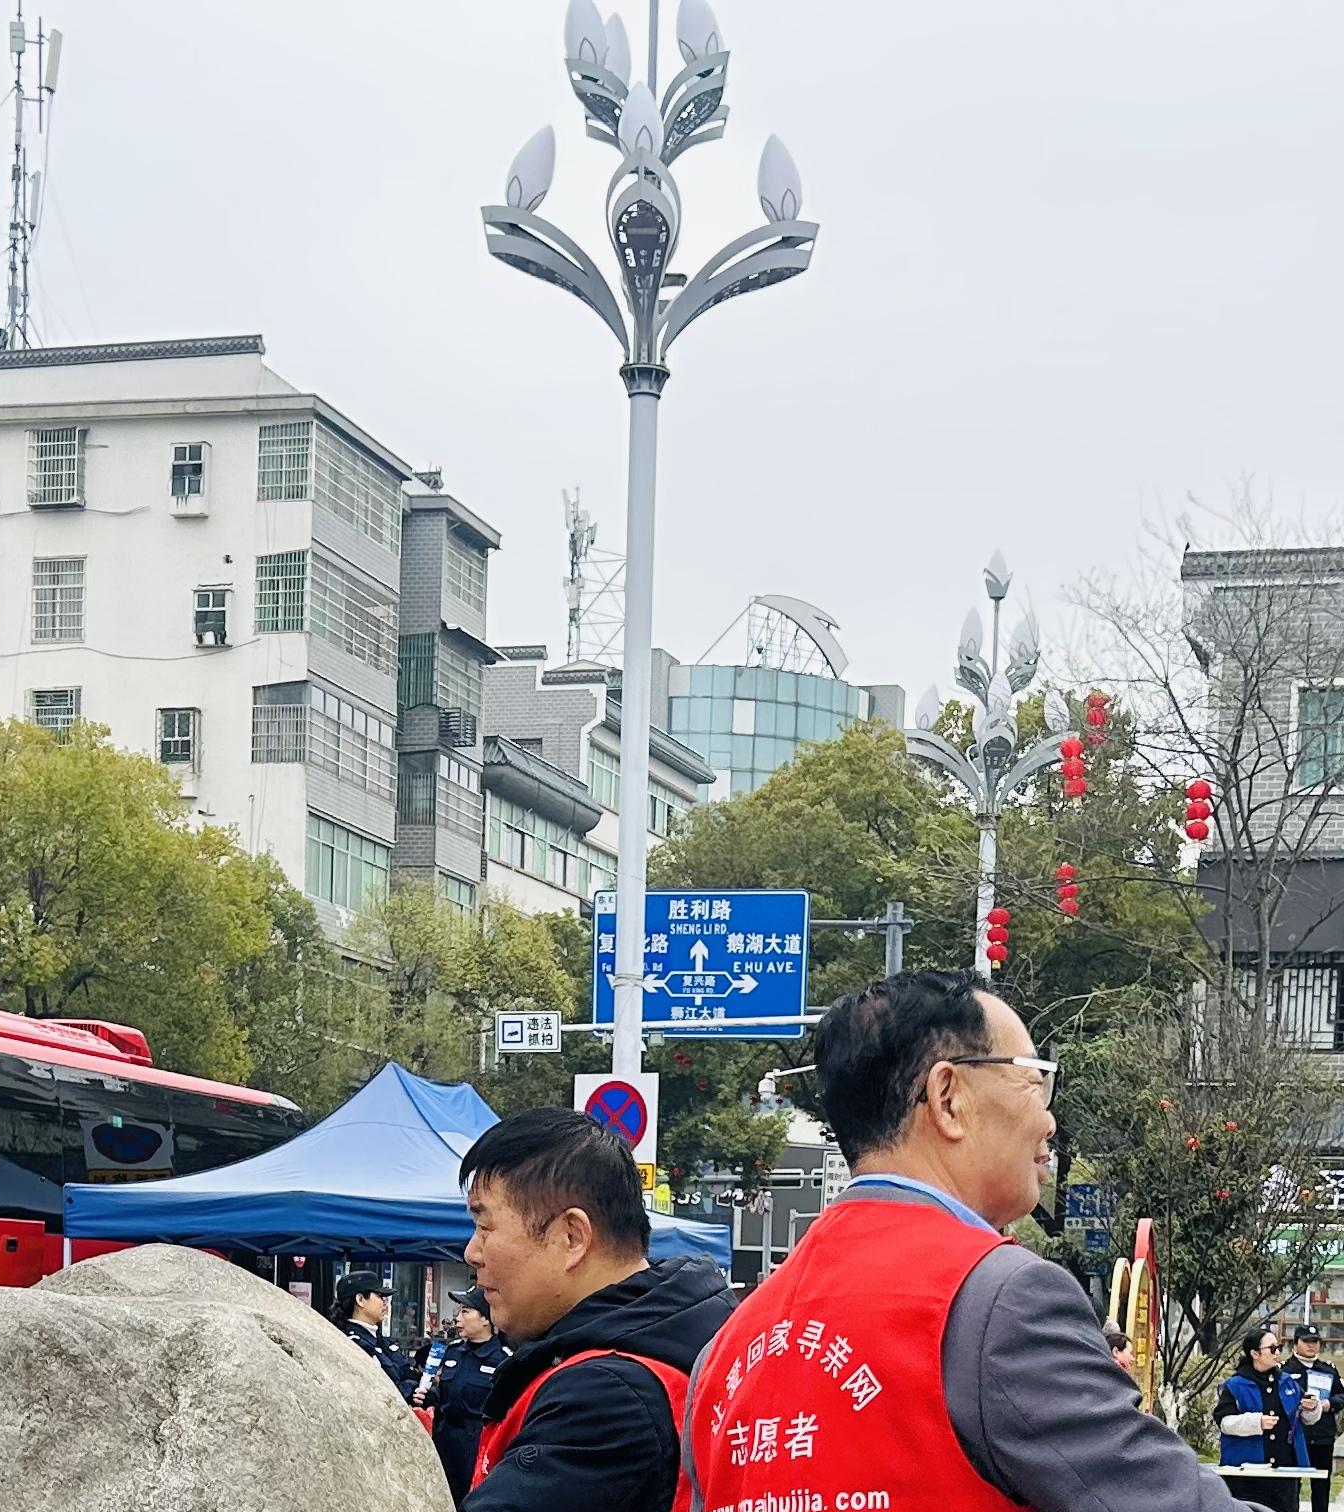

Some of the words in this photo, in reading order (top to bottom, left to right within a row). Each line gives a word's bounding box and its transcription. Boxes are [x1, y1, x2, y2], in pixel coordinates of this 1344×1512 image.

[668, 899, 732, 921] 胜利路
[670, 923, 701, 936] SHENG
[726, 934, 802, 955] 鹅湖大道
[733, 962, 741, 973] E
[745, 962, 763, 973] HU
[727, 1411, 819, 1466] 志愿者
